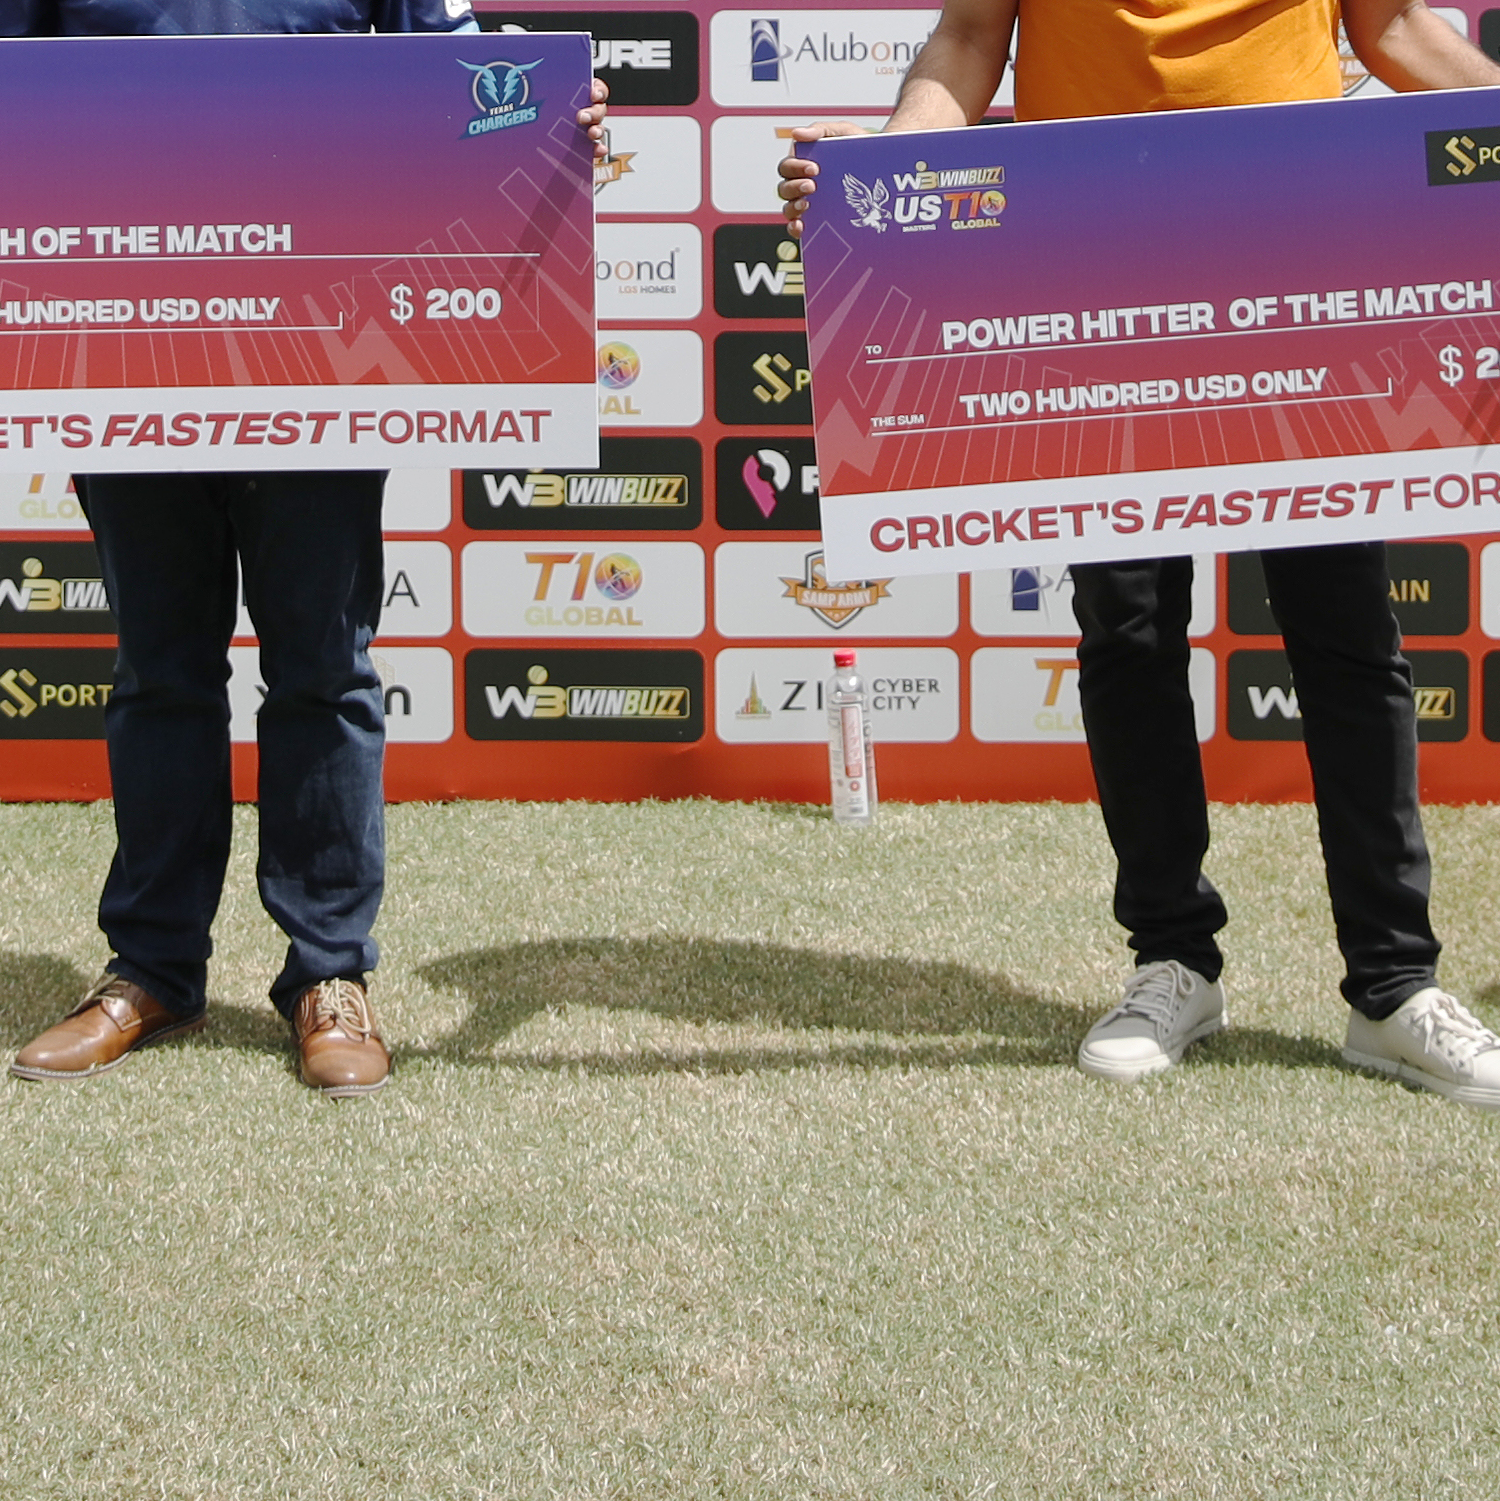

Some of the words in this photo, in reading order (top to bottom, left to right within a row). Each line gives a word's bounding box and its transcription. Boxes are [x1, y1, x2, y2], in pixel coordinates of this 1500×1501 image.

[468, 106, 537, 135] CHARGERS
[489, 103, 514, 115] TEXAS
[940, 168, 1001, 187] WINBUZZ
[893, 196, 942, 223] US
[951, 219, 1001, 230] GLOBAL
[31, 227, 81, 255] OF
[87, 225, 159, 254] THE
[166, 224, 293, 253] MATCH
[139, 298, 200, 321] USD
[205, 297, 280, 321] ONLY
[390, 283, 415, 325] $
[426, 288, 502, 319] 200
[942, 313, 1075, 350] POWER
[1082, 301, 1215, 339] HITTER
[1228, 297, 1278, 328] OF
[1285, 290, 1358, 322] THE
[1365, 279, 1493, 316] MATCH
[865, 345, 882, 355] TO
[1439, 345, 1464, 387] $
[959, 390, 1031, 418] TWO
[1036, 379, 1180, 413] HUNDRED
[1184, 373, 1247, 401] USD
[1251, 367, 1327, 395] ONLY
[101, 411, 340, 447] FASTEST
[349, 409, 552, 444] FORMAT
[871, 416, 896, 427] THE
[897, 414, 925, 425] SUM
[870, 499, 1144, 552] CRICKET'S
[1153, 479, 1395, 526] FASTEST
[525, 552, 643, 601] T10
[524, 607, 642, 627] GLOBAL
